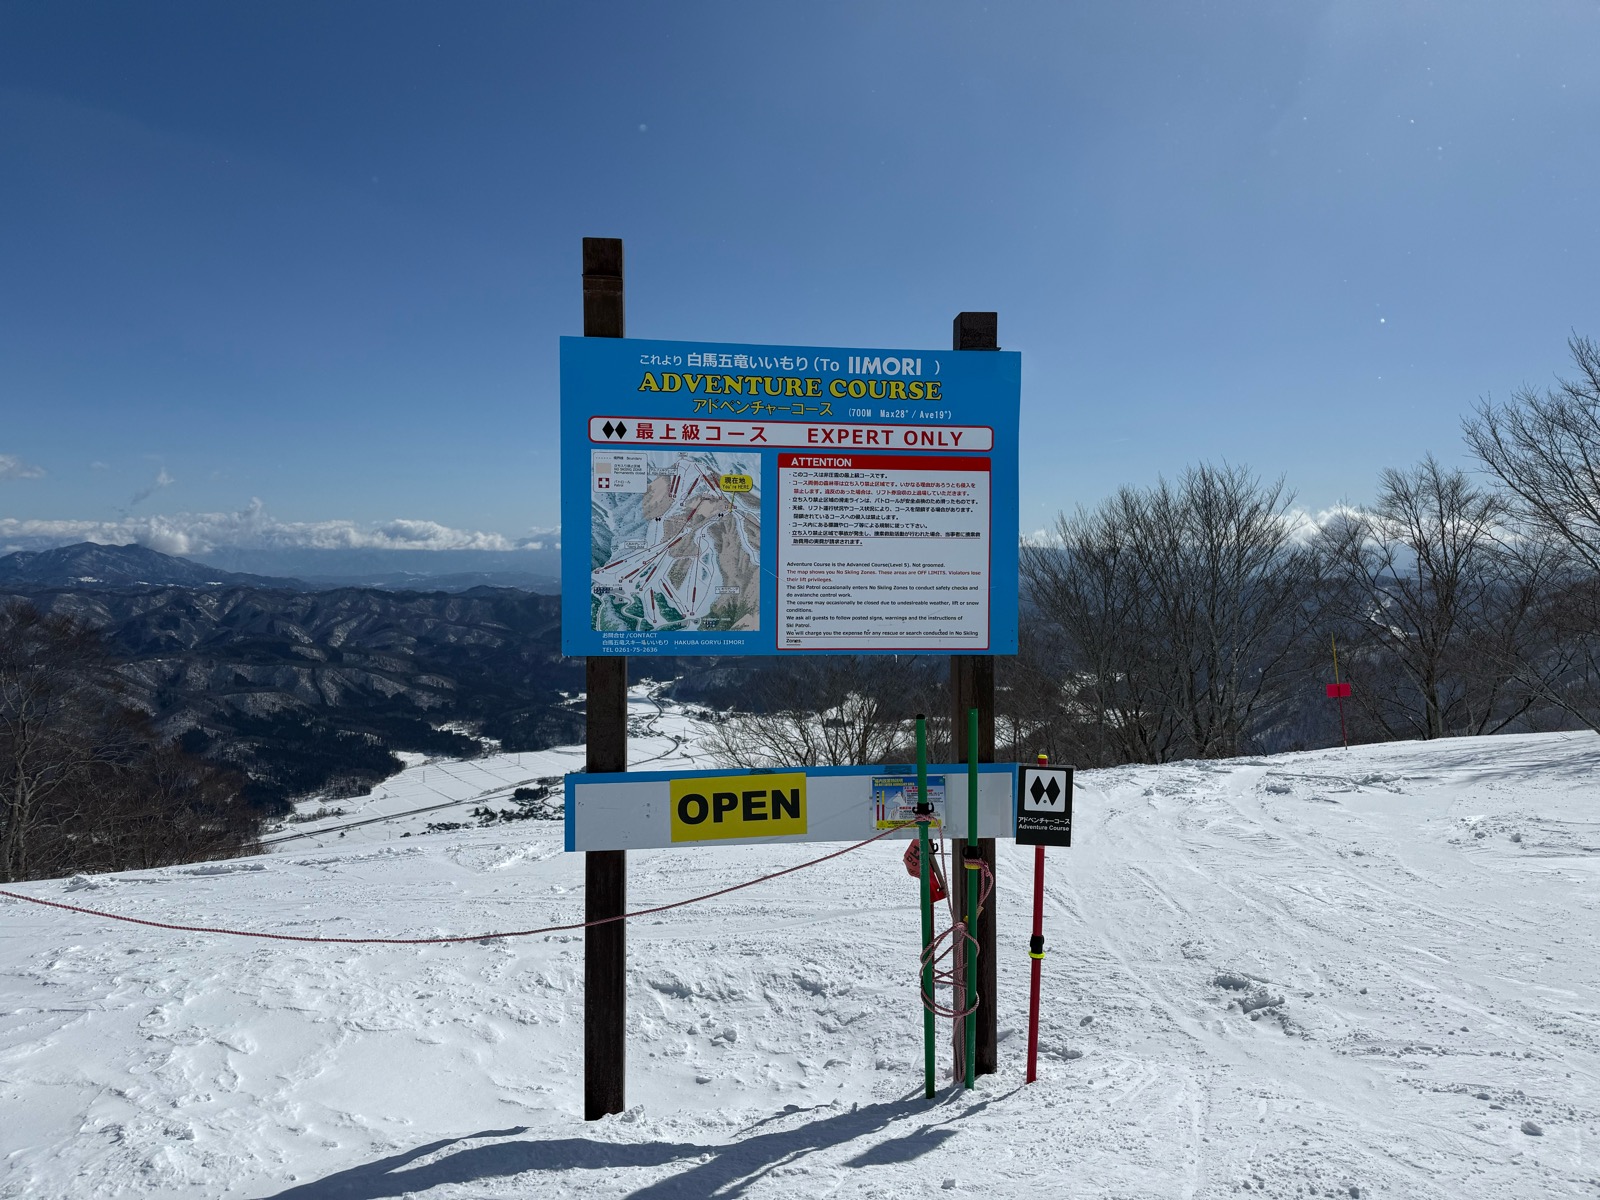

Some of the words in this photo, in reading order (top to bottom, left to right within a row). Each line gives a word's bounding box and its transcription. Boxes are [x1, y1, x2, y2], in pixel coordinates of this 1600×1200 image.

[640, 354, 682, 366] これより
[848, 356, 922, 376] IIMORI
[638, 372, 822, 397] ADVENTURE
[829, 378, 942, 400] COURSE
[693, 398, 833, 416] アドベンチャーコース
[848, 408, 872, 418] (700M
[636, 423, 768, 442] 最上級コース
[808, 428, 894, 445] EXPERT
[904, 430, 964, 446] ONLY
[791, 457, 852, 467] ATTENTION
[676, 788, 800, 826] OPEN
[1018, 816, 1070, 825] アドベンチャーコース
